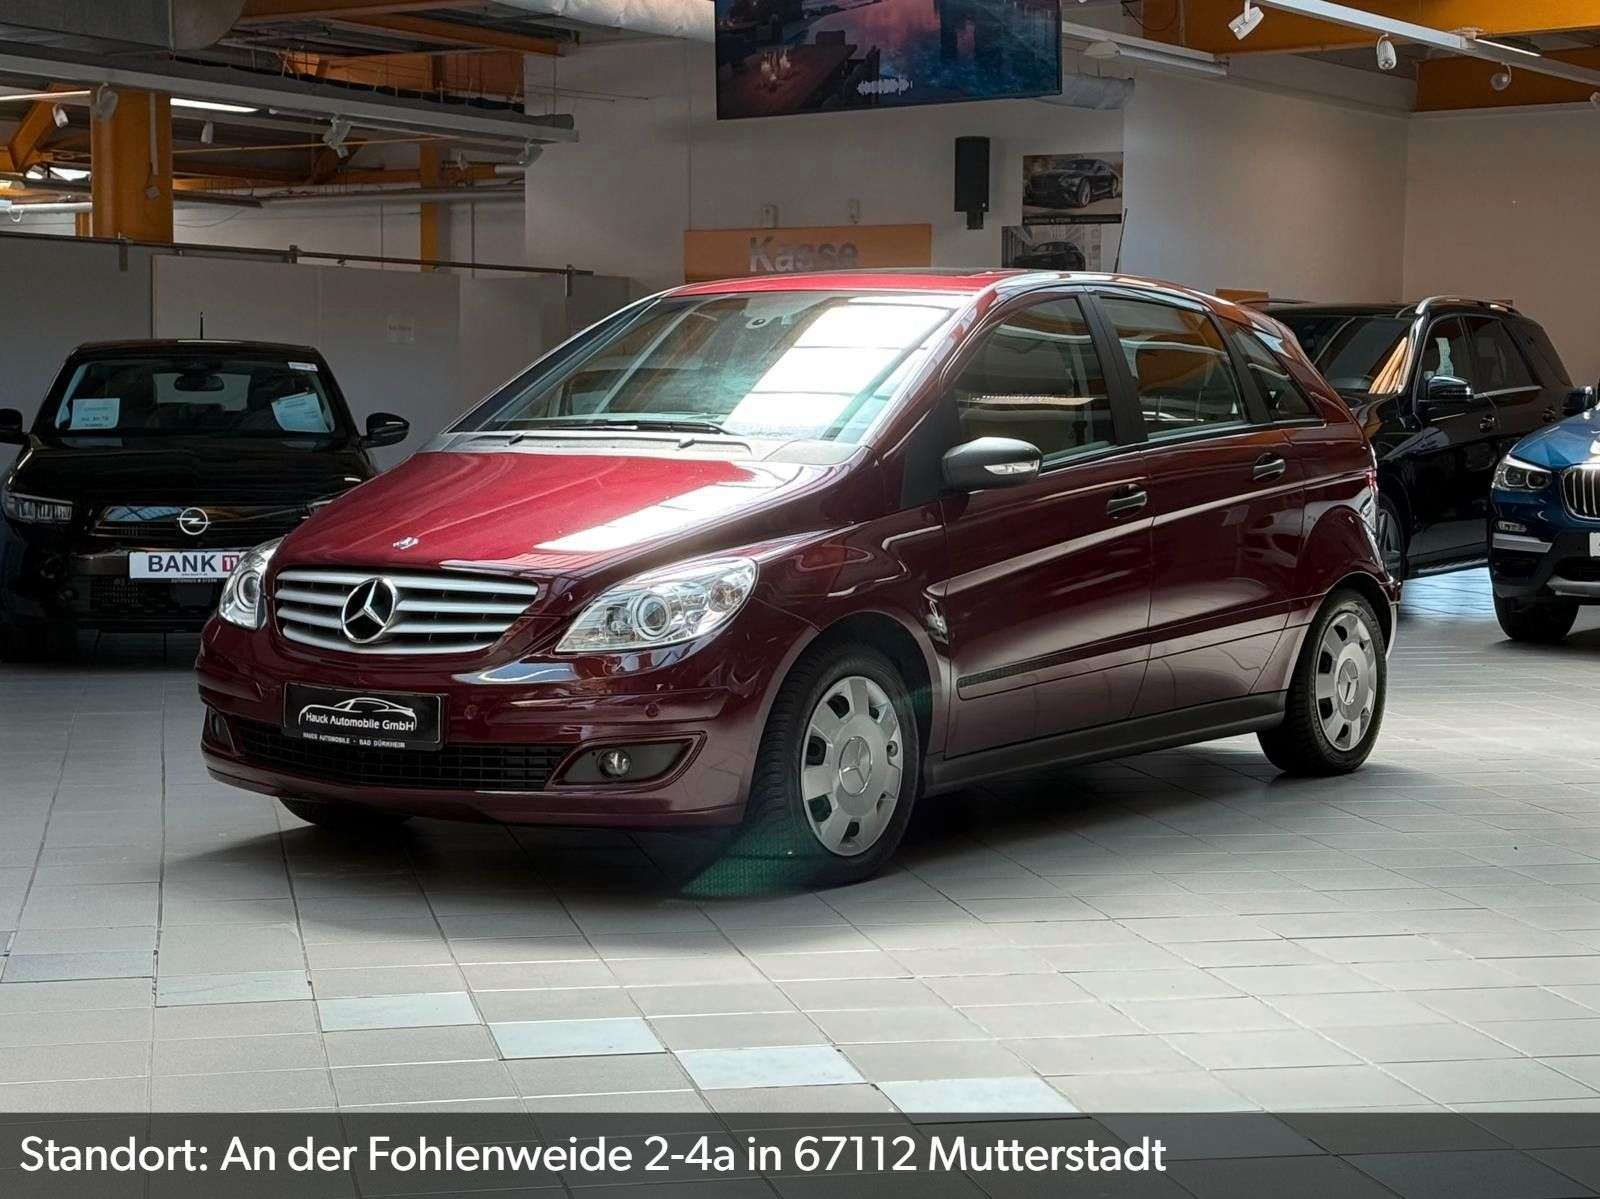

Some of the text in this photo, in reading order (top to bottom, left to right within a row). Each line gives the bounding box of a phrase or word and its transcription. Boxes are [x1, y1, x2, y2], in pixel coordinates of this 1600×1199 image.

[749, 235, 859, 272] Kasse
[148, 555, 217, 573] BANK
[305, 712, 414, 731] Hauck Automobile GmbH
[303, 732, 318, 740] HAUCK
[319, 734, 351, 744] AUTOMOBILE
[373, 740, 406, 749] DÜRKHEIM
